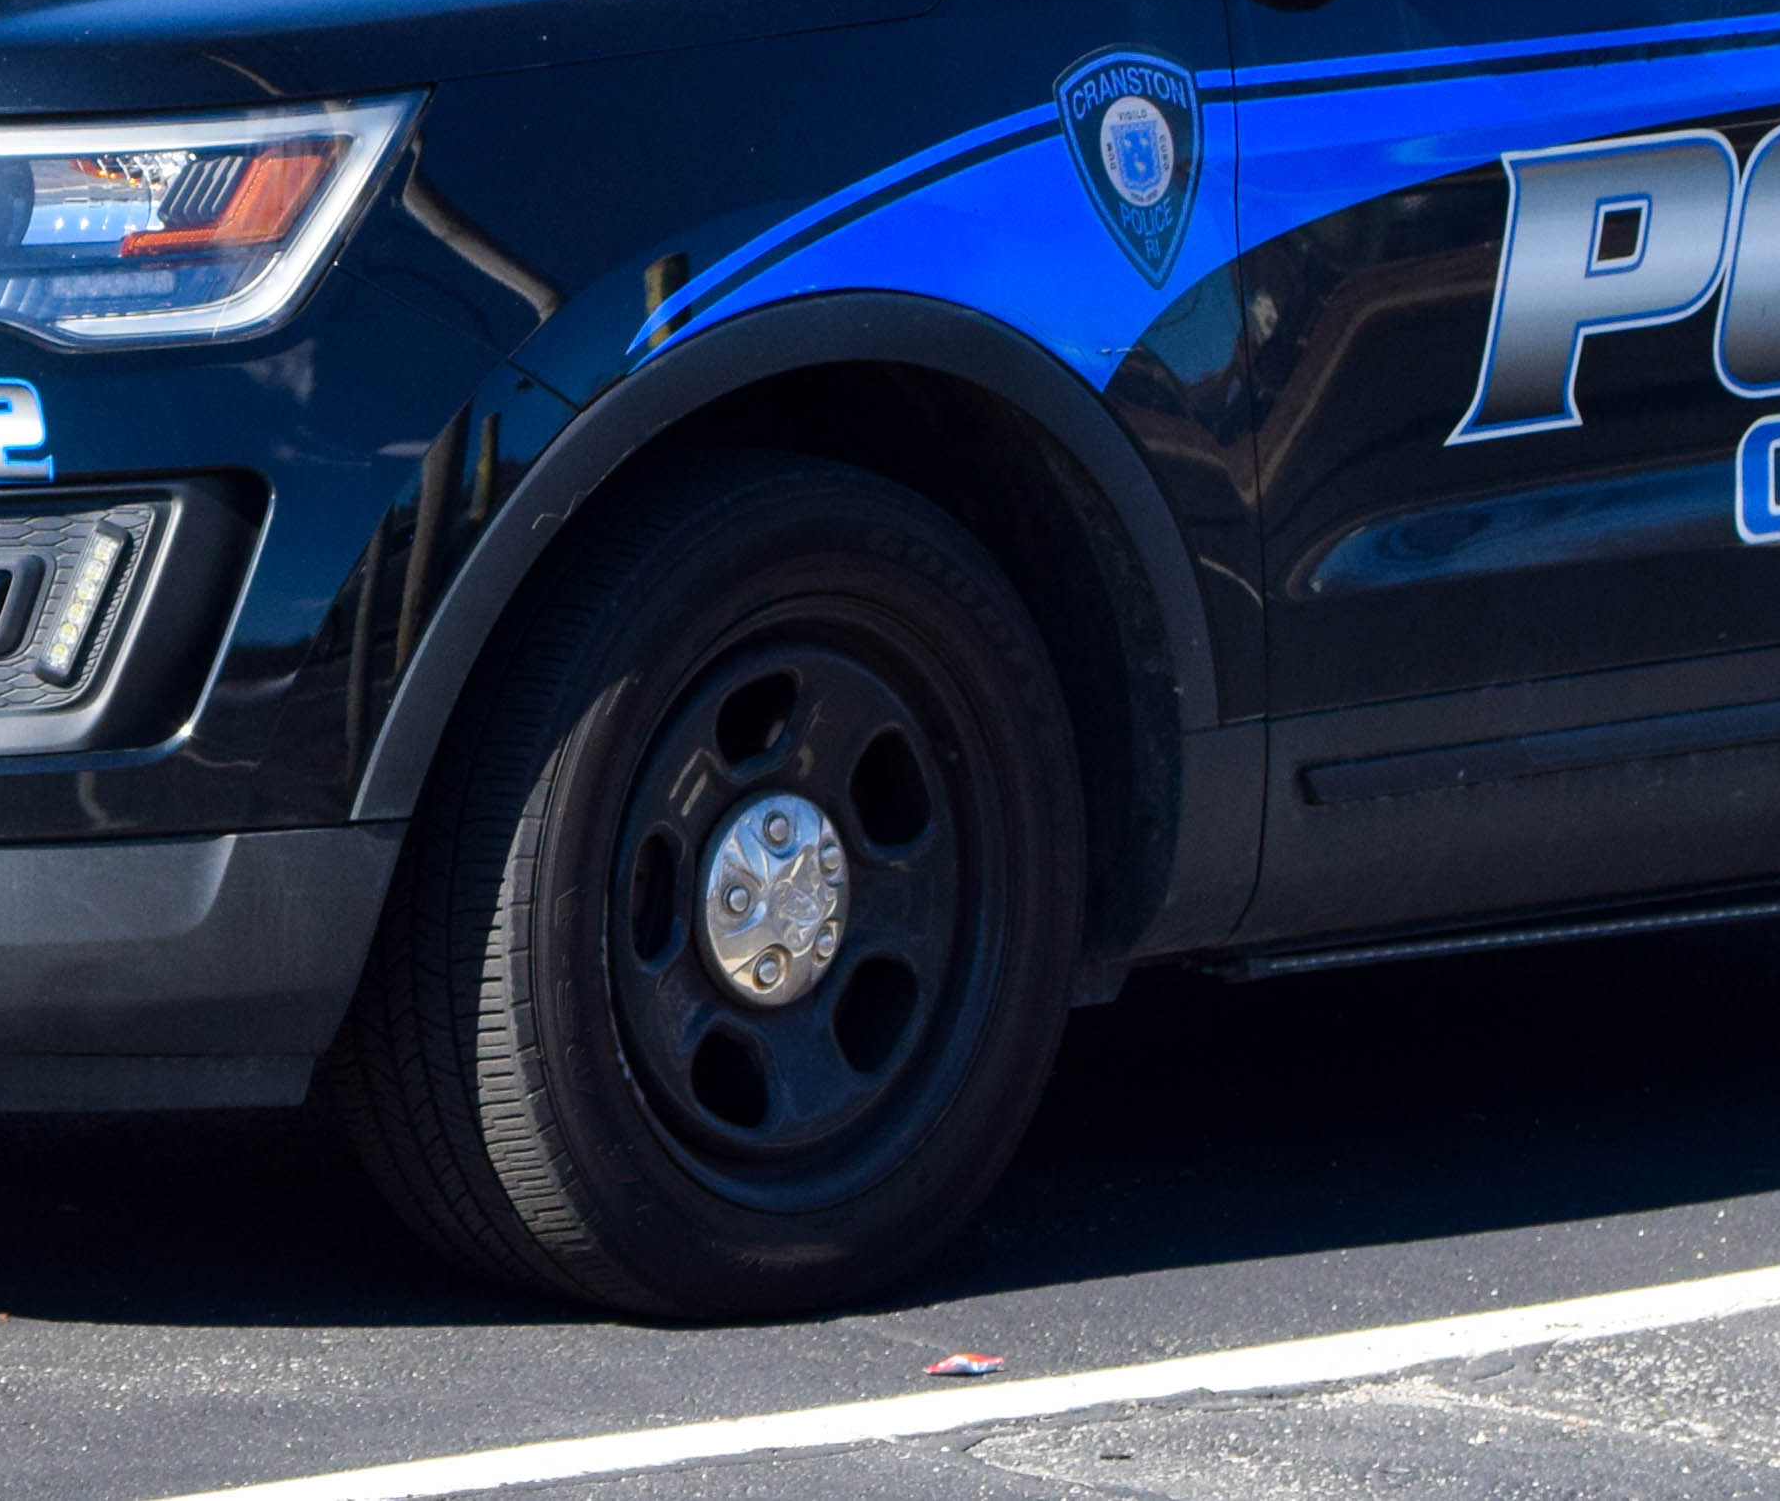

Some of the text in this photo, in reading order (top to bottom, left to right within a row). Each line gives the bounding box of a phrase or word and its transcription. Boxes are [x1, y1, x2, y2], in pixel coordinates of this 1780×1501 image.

[1073, 67, 1187, 119] CRANSTON
[1121, 199, 1173, 235] POLICE
[1145, 238, 1162, 259] RI
